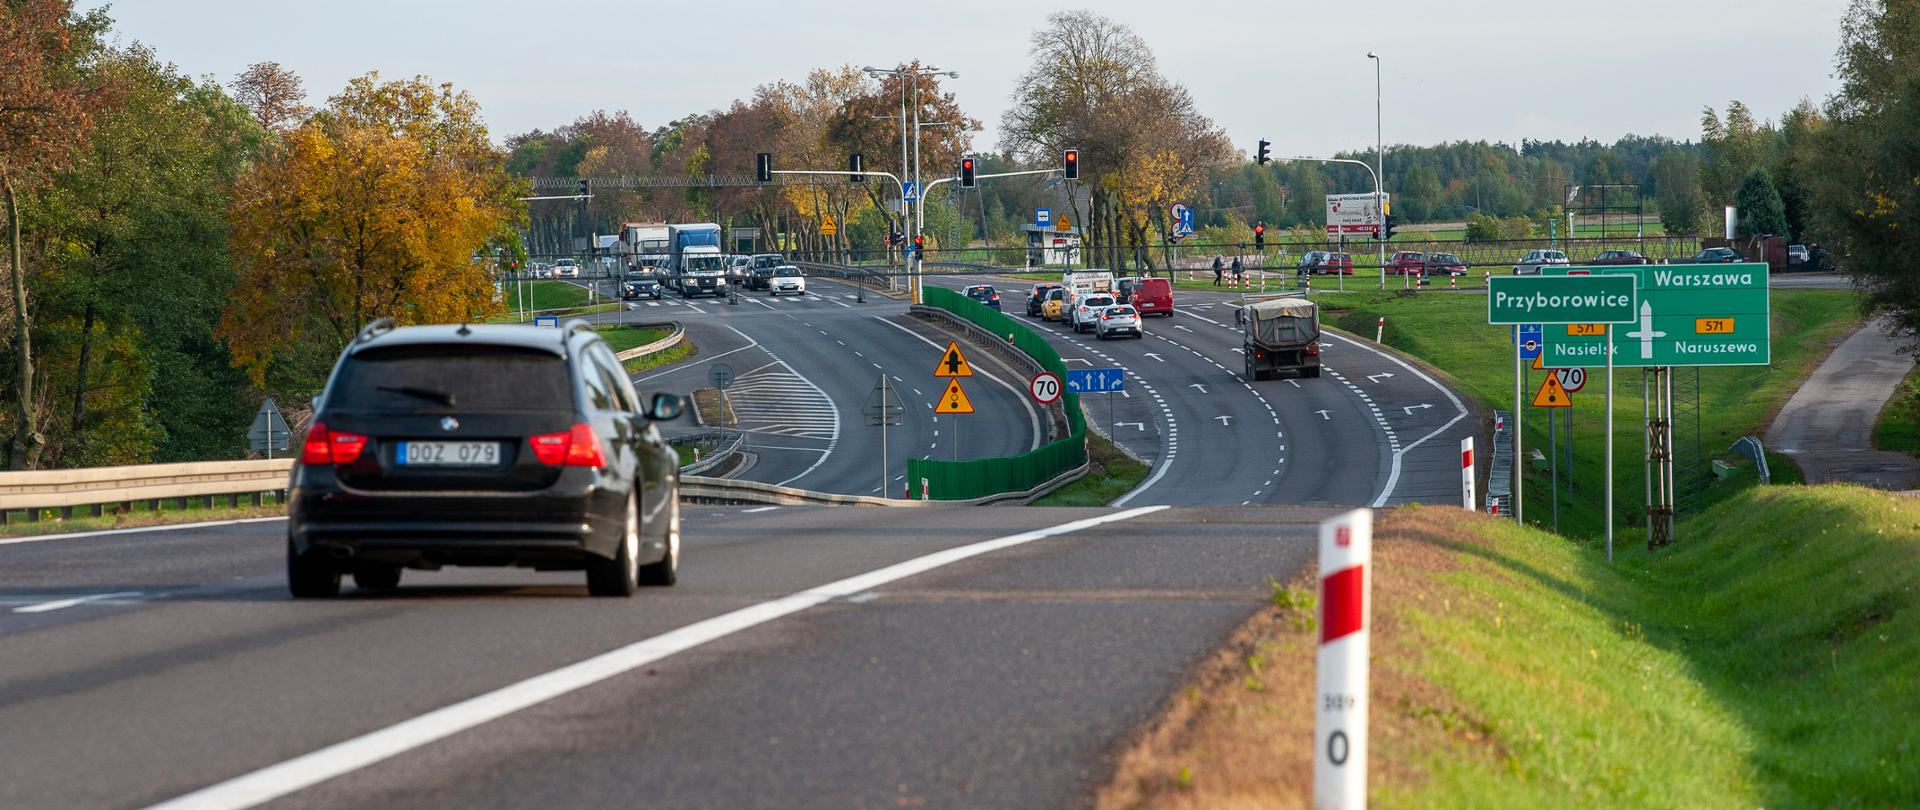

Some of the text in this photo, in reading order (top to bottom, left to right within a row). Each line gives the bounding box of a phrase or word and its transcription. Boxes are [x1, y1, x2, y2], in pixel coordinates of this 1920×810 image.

[1654, 270, 1752, 287] Warszawa
[1496, 290, 1629, 313] Przyborowice
[1577, 324, 1594, 333] 571
[1706, 321, 1723, 331] 571
[1675, 341, 1757, 354] Naruszewo
[1561, 369, 1582, 385] 70
[1036, 380, 1057, 396] 70
[458, 444, 495, 461] 079
[1327, 728, 1349, 767] 0
